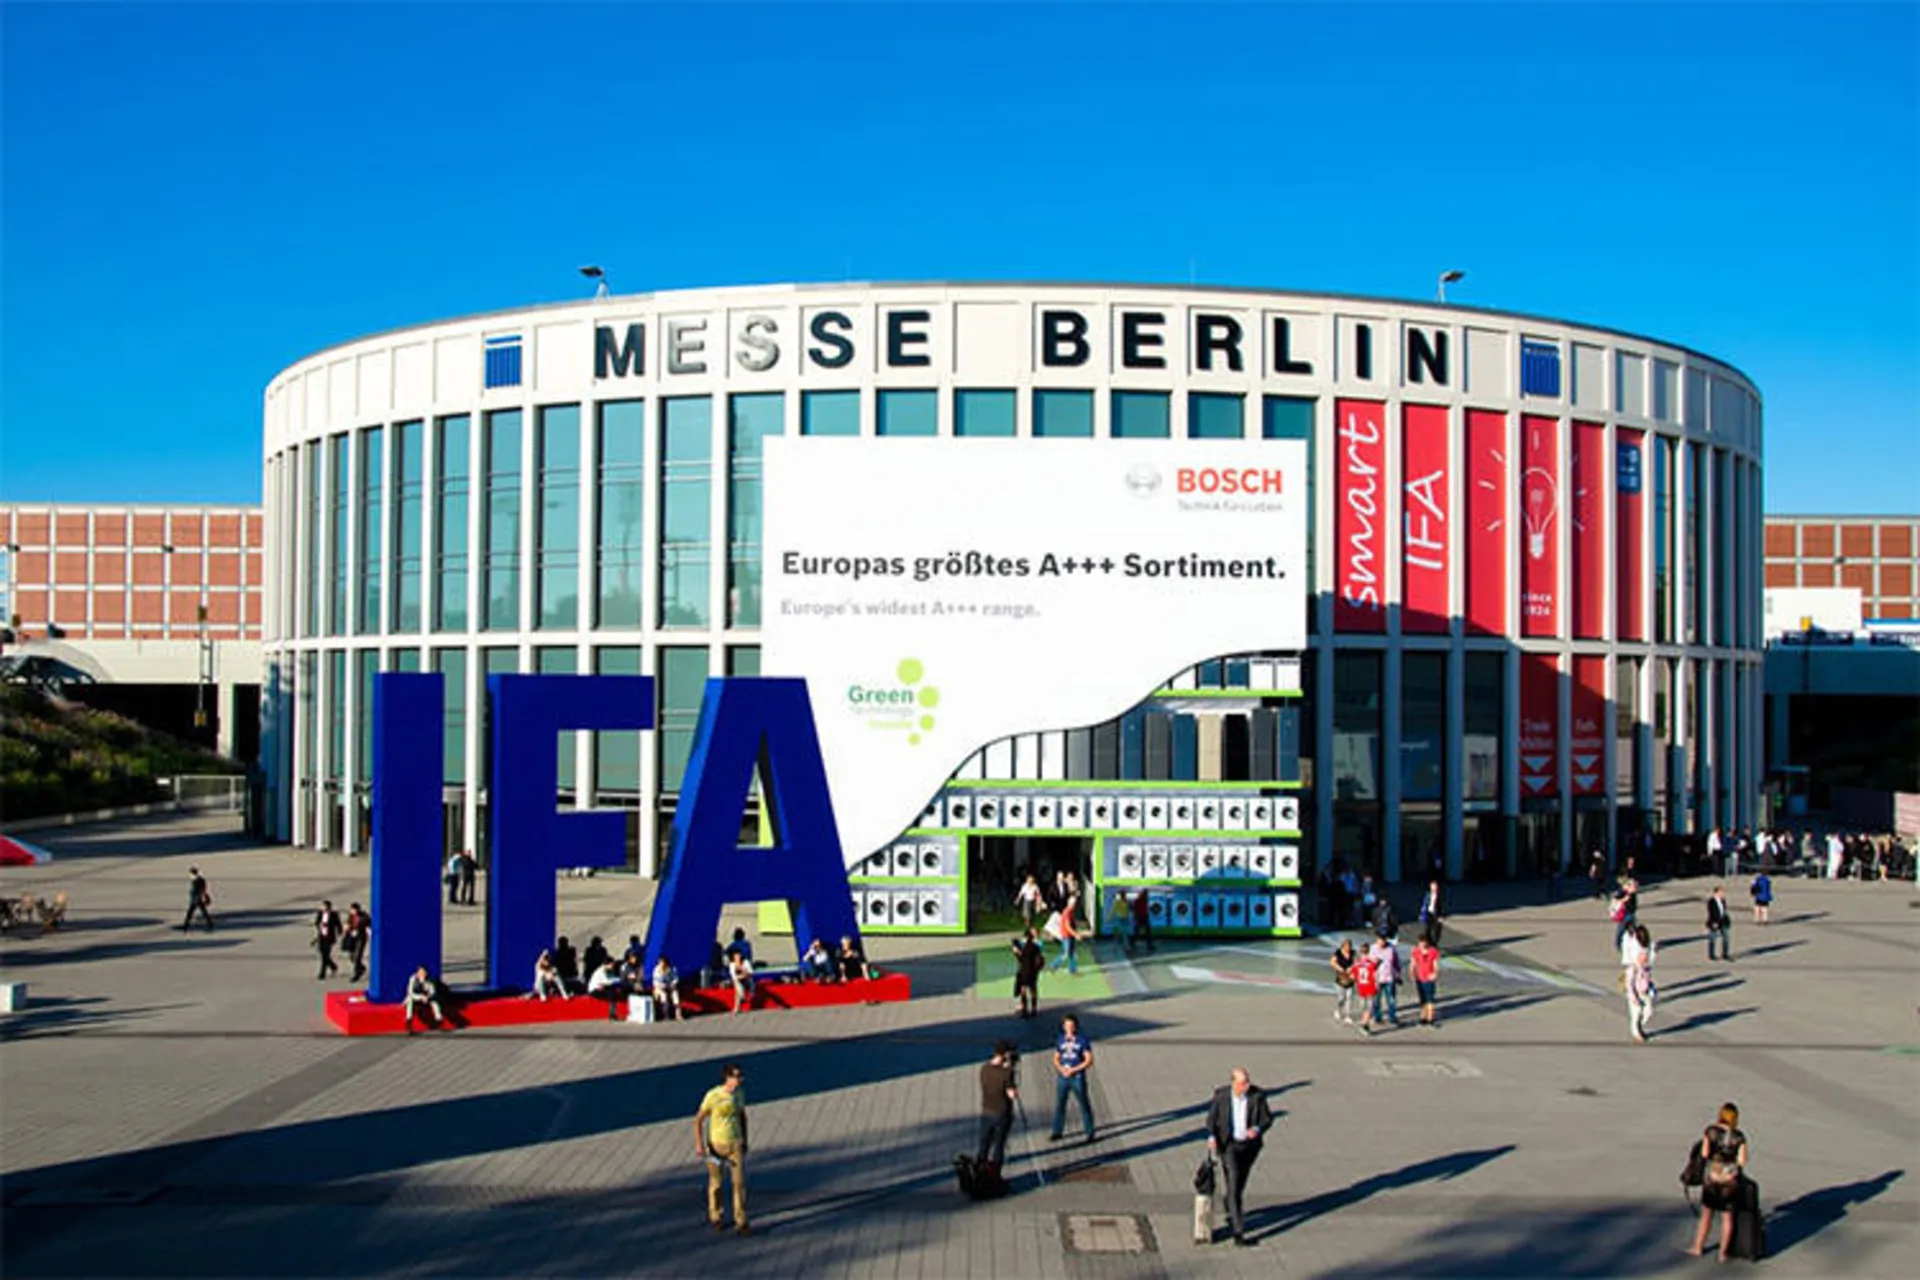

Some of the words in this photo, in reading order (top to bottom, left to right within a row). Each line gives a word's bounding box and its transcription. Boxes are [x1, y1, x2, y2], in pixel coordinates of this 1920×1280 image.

[594, 310, 931, 380] MESSE
[1041, 310, 1450, 386] BERLIN
[1176, 468, 1283, 494] BOSCH
[1339, 413, 1380, 612] smart
[1405, 469, 1445, 570] IFA
[782, 551, 906, 582] Europas
[912, 549, 1031, 582] größtes
[1038, 552, 1116, 577] A+++
[1123, 552, 1286, 580] Sortiment.
[865, 599, 927, 616] widest
[931, 600, 978, 616] A+++
[982, 602, 1041, 619] range.
[847, 684, 915, 704] Green
[368, 672, 867, 1005] IFA
